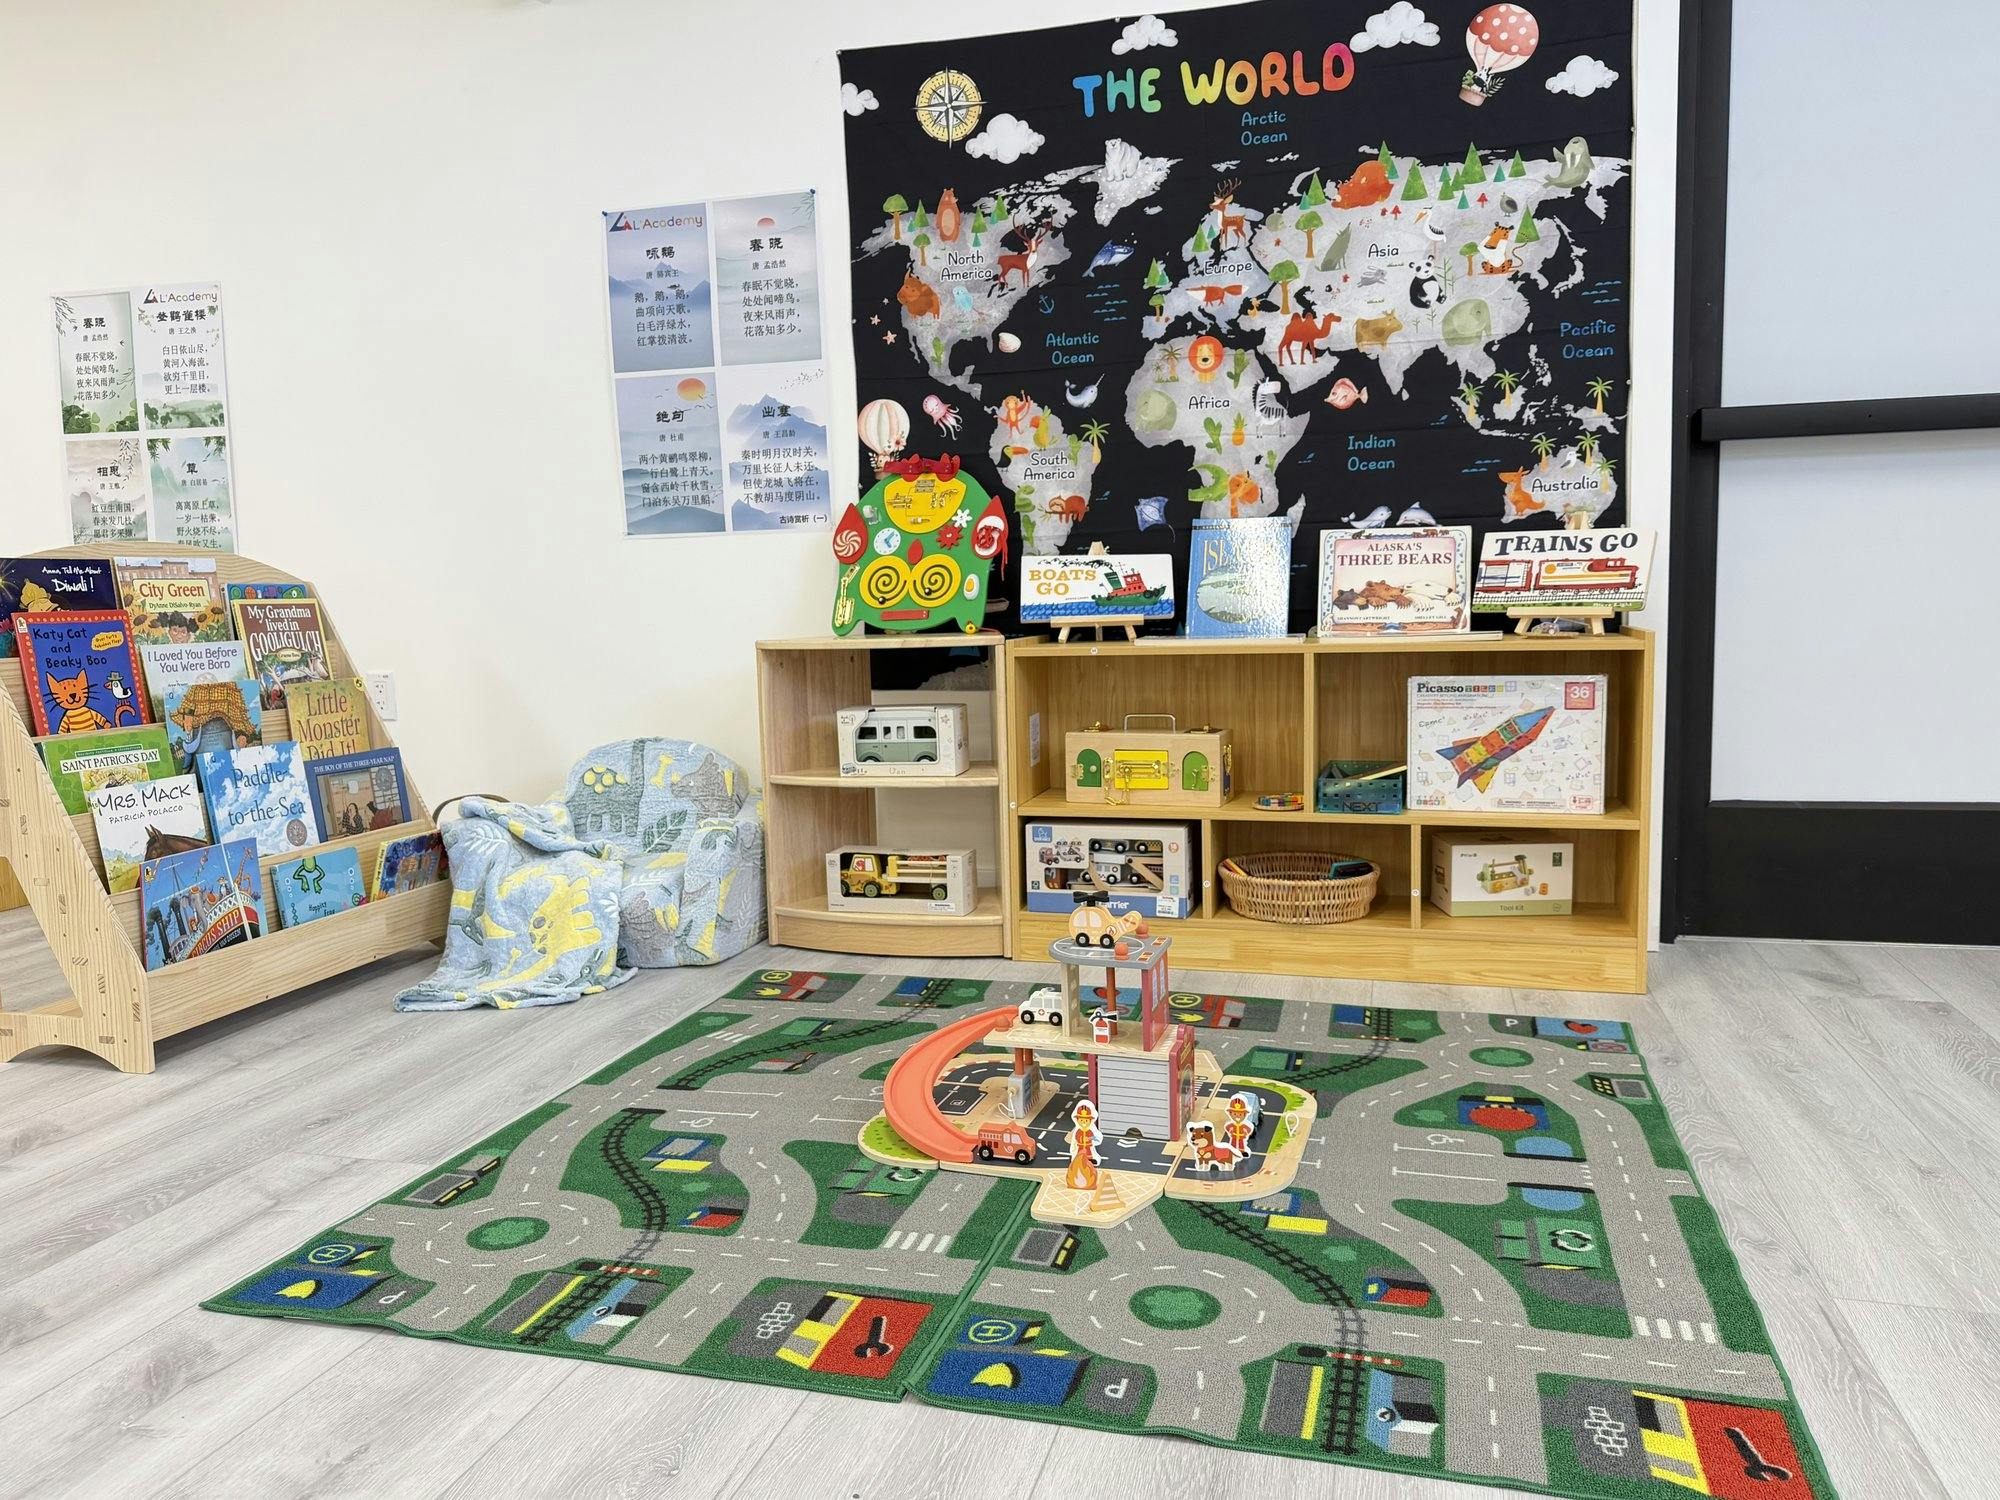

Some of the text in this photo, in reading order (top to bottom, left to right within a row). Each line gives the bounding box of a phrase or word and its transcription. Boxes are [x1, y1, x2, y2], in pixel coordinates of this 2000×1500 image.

[1073, 42, 1355, 118] THE WORLD
[1241, 111, 1287, 126] Arctic
[1241, 130, 1288, 146] Ocean
[1368, 243, 1399, 258] Asia
[752, 259, 787, 270] 唐 孟浩然
[947, 251, 985, 266] North
[941, 267, 993, 281] America
[1204, 259, 1253, 277] Europe
[1560, 320, 1617, 337] Pacific
[1045, 331, 1100, 348] Atlantic
[1051, 350, 1095, 365] Ocean
[1562, 343, 1614, 358] Ocean
[1188, 395, 1231, 410] Africa
[656, 409, 685, 423] 绝句
[659, 432, 685, 442] 唐 杜甫
[762, 430, 770, 439] 唐
[1347, 434, 1396, 450] Indian
[1030, 452, 1069, 466] South
[1347, 456, 1396, 471] Ocean
[1024, 466, 1076, 481] America
[1531, 476, 1599, 493] Australia
[1367, 542, 1422, 552] ALASKA'S
[1495, 532, 1639, 557] TRAINS GO
[1337, 552, 1453, 567] THREE BEARS
[1029, 569, 1096, 581] BOATS
[139, 582, 205, 600] City Green
[1036, 582, 1069, 595] GO
[247, 605, 311, 622] My Grandma
[265, 618, 300, 631] lived in
[32, 628, 63, 642] Katy
[67, 627, 87, 639] Cat
[51, 644, 71, 653] and
[249, 630, 321, 661] GOOLIGULCH
[46, 655, 107, 669] Beaky Boo
[148, 647, 237, 662] I Loved You Before
[160, 659, 231, 672] You Were Born
[1416, 682, 1464, 693] Picasso
[1570, 686, 1590, 699] 36
[305, 688, 347, 717] Little
[297, 716, 361, 744] Monster
[307, 741, 335, 761] Did
[62, 759, 91, 772] SAINT
[94, 752, 140, 768] PATRICK'S
[141, 750, 158, 762] DAY
[97, 793, 138, 816] MRS.
[141, 784, 191, 808] MACK
[1343, 801, 1381, 812] NEXT
[109, 805, 183, 824] PATRICIA POLACCO
[228, 796, 306, 826] to-the-Sea
[216, 909, 240, 936] SHIP
[1505, 1018, 1519, 1028] P
[1105, 1378, 1130, 1400] P
